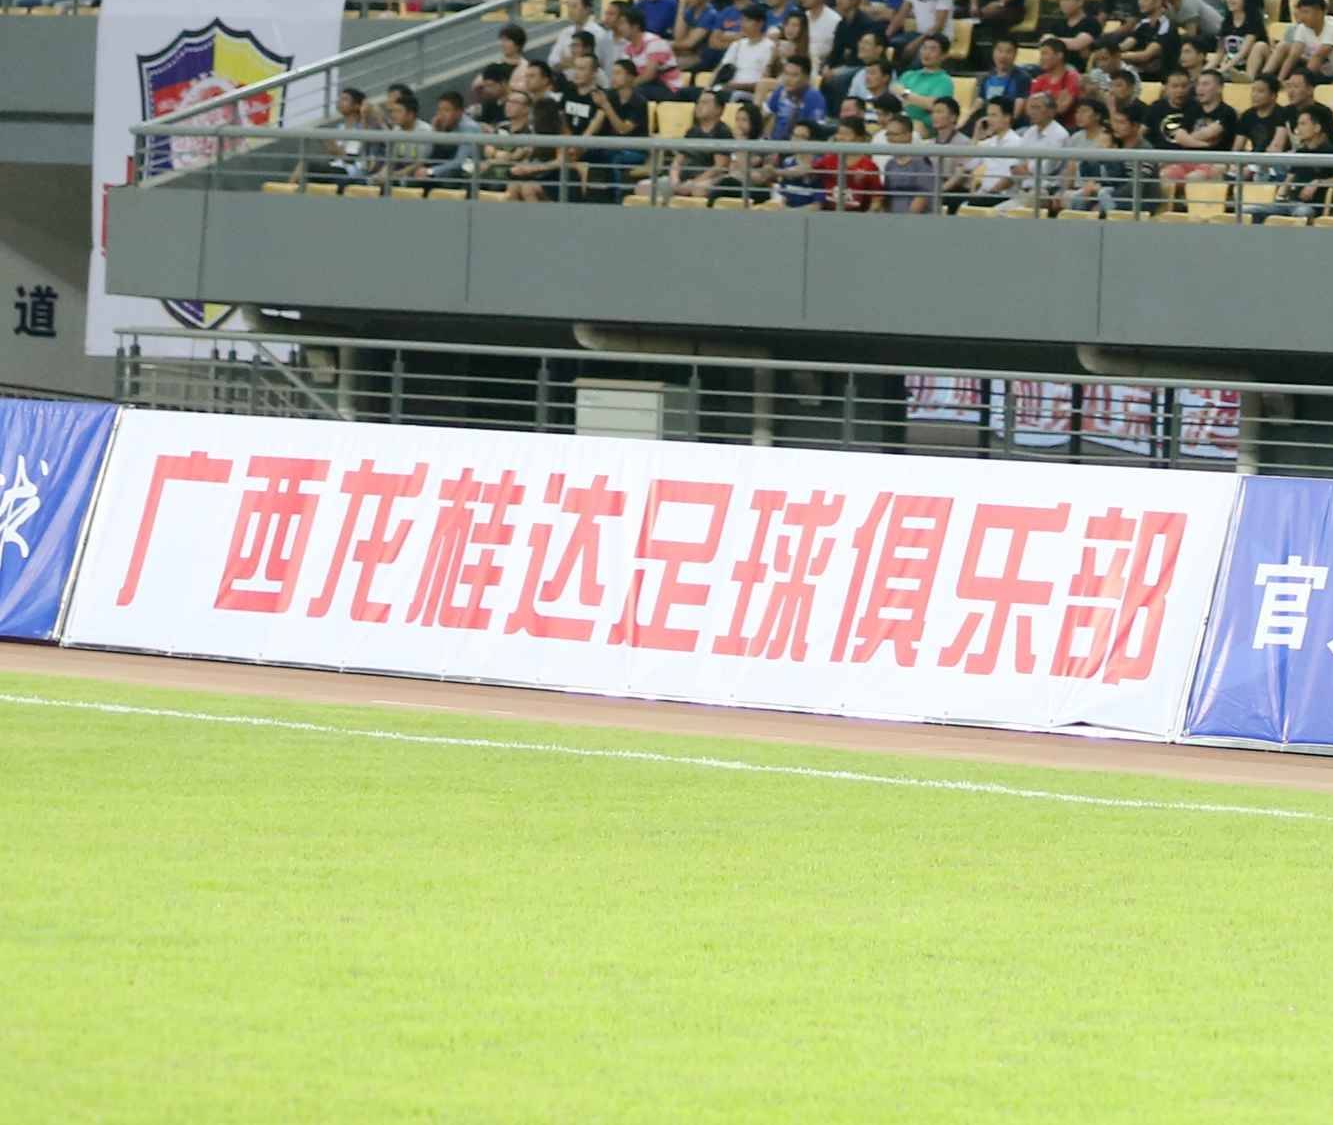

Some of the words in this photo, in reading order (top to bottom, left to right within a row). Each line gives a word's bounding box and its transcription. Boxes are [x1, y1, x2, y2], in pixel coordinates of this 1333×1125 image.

[13, 284, 59, 339] 道
[116, 451, 1188, 686] 广西龙桂达足球俱乐部
